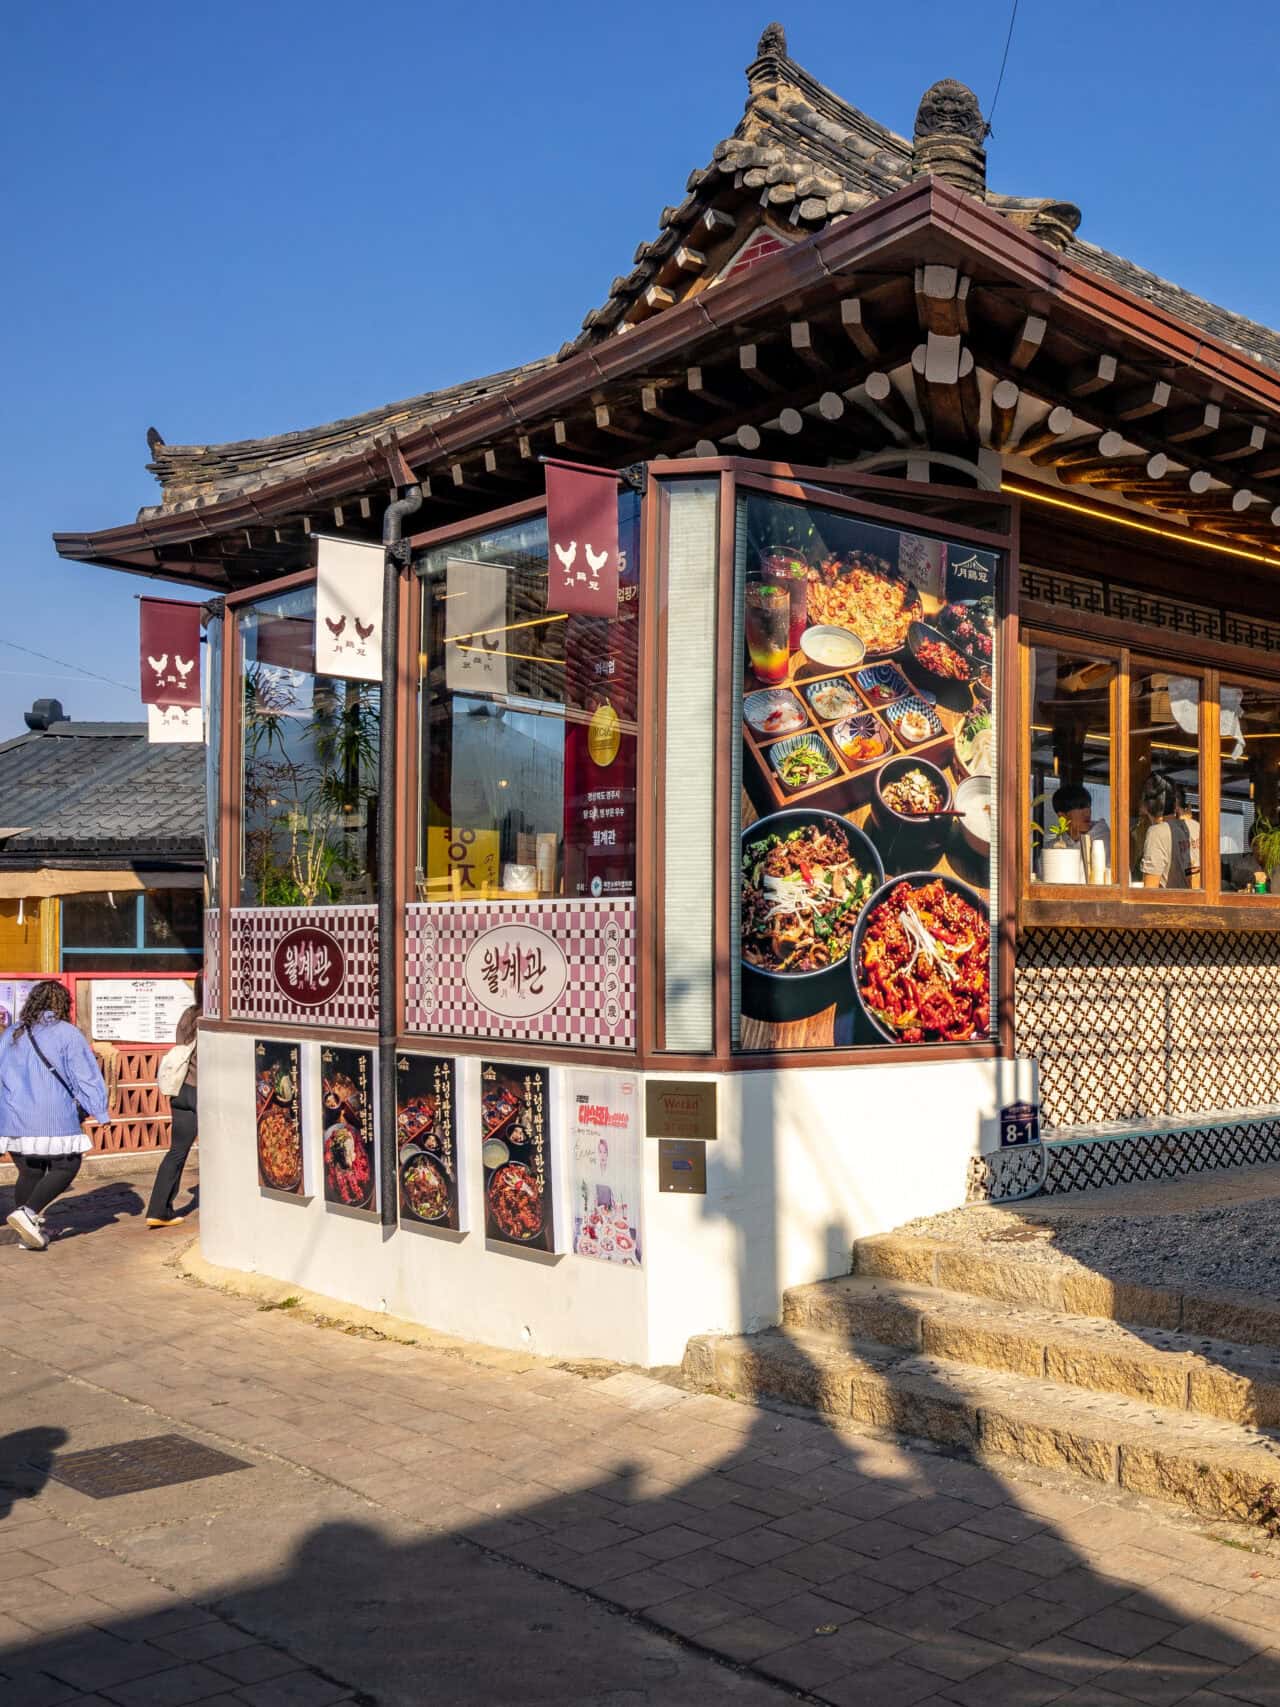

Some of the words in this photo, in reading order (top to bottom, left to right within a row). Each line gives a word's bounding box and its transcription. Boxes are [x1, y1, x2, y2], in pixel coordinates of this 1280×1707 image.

[283, 944, 332, 987] 월계관
[481, 946, 547, 994] 월계관
[1006, 1122, 1033, 1143] 8-1
